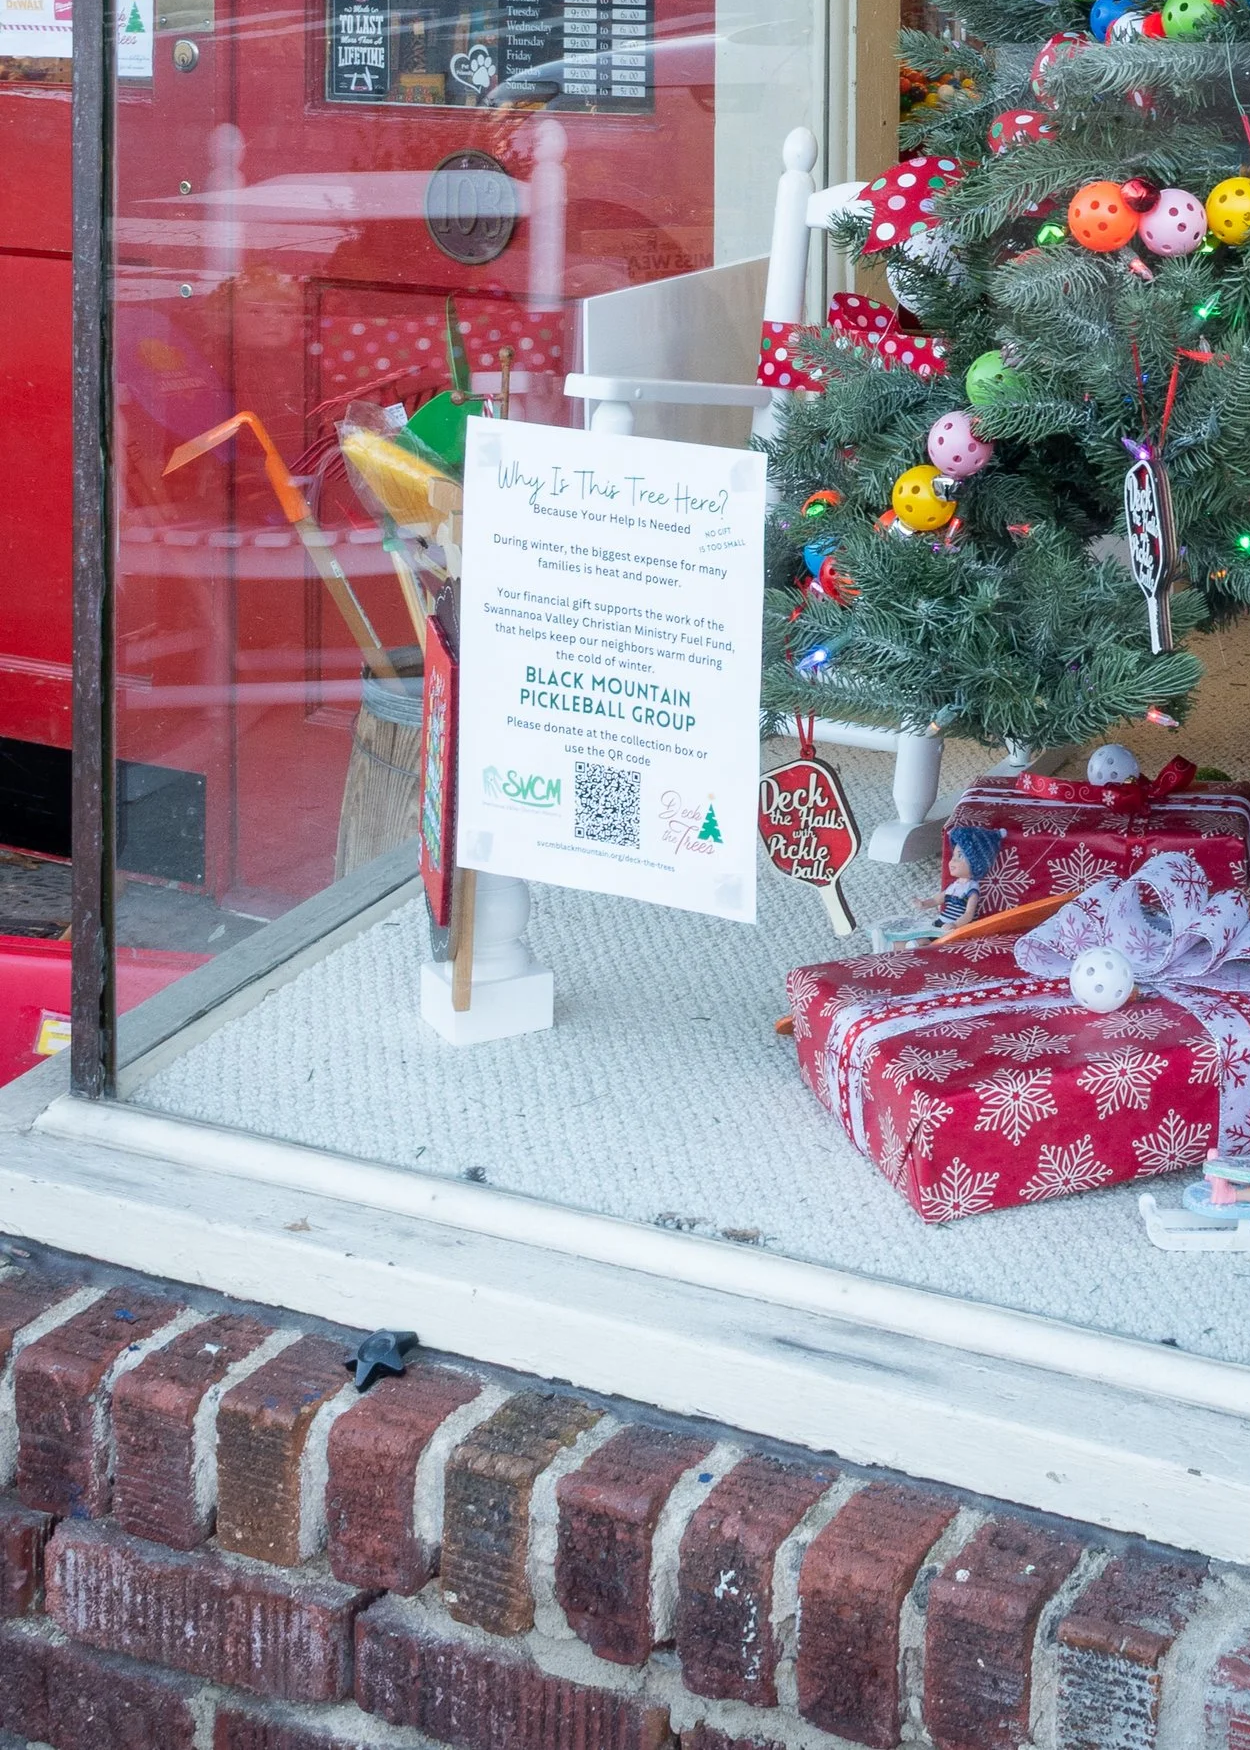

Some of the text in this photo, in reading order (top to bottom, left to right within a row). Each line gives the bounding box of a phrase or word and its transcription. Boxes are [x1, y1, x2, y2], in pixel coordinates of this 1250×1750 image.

[339, 15, 384, 35] TO LAST
[506, 6, 540, 18] Tuesday
[600, 11, 609, 19] to
[506, 21, 552, 33] Wednesday
[600, 27, 609, 35] to
[338, 46, 385, 69] LIFETIME
[506, 35, 545, 47] Thursday
[600, 42, 609, 50] to
[506, 50, 532, 61] Friday
[506, 80, 536, 91] Sunday
[438, 172, 501, 238] 103
[498, 460, 729, 520] Why Is This Tree Here?
[533, 503, 691, 535] Because Your Help Is Needed
[493, 533, 728, 580] During winter, the biggest expense for many
[537, 557, 681, 588] families is heat and power.
[497, 587, 725, 632] Your financial gift supports the work of the
[483, 602, 735, 654] Swannanoa Valley Christian Ministry Fuel Fund,
[495, 622, 723, 671] that helps keep our neighbors warm during
[555, 649, 655, 674] the cold of winter.
[526, 665, 691, 708] BLACK MOUNTAIN
[520, 688, 696, 732] PICKLEBALL GROUP
[507, 715, 708, 760] Please donate at the collection box or
[564, 744, 651, 767] use the QR code
[502, 770, 561, 805] SVCM
[760, 773, 829, 815] Deck
[658, 790, 701, 821] Deck
[770, 809, 846, 830] the Halls
[669, 819, 715, 855] Trees
[768, 833, 830, 862] Pickle
[791, 859, 835, 882] balls
